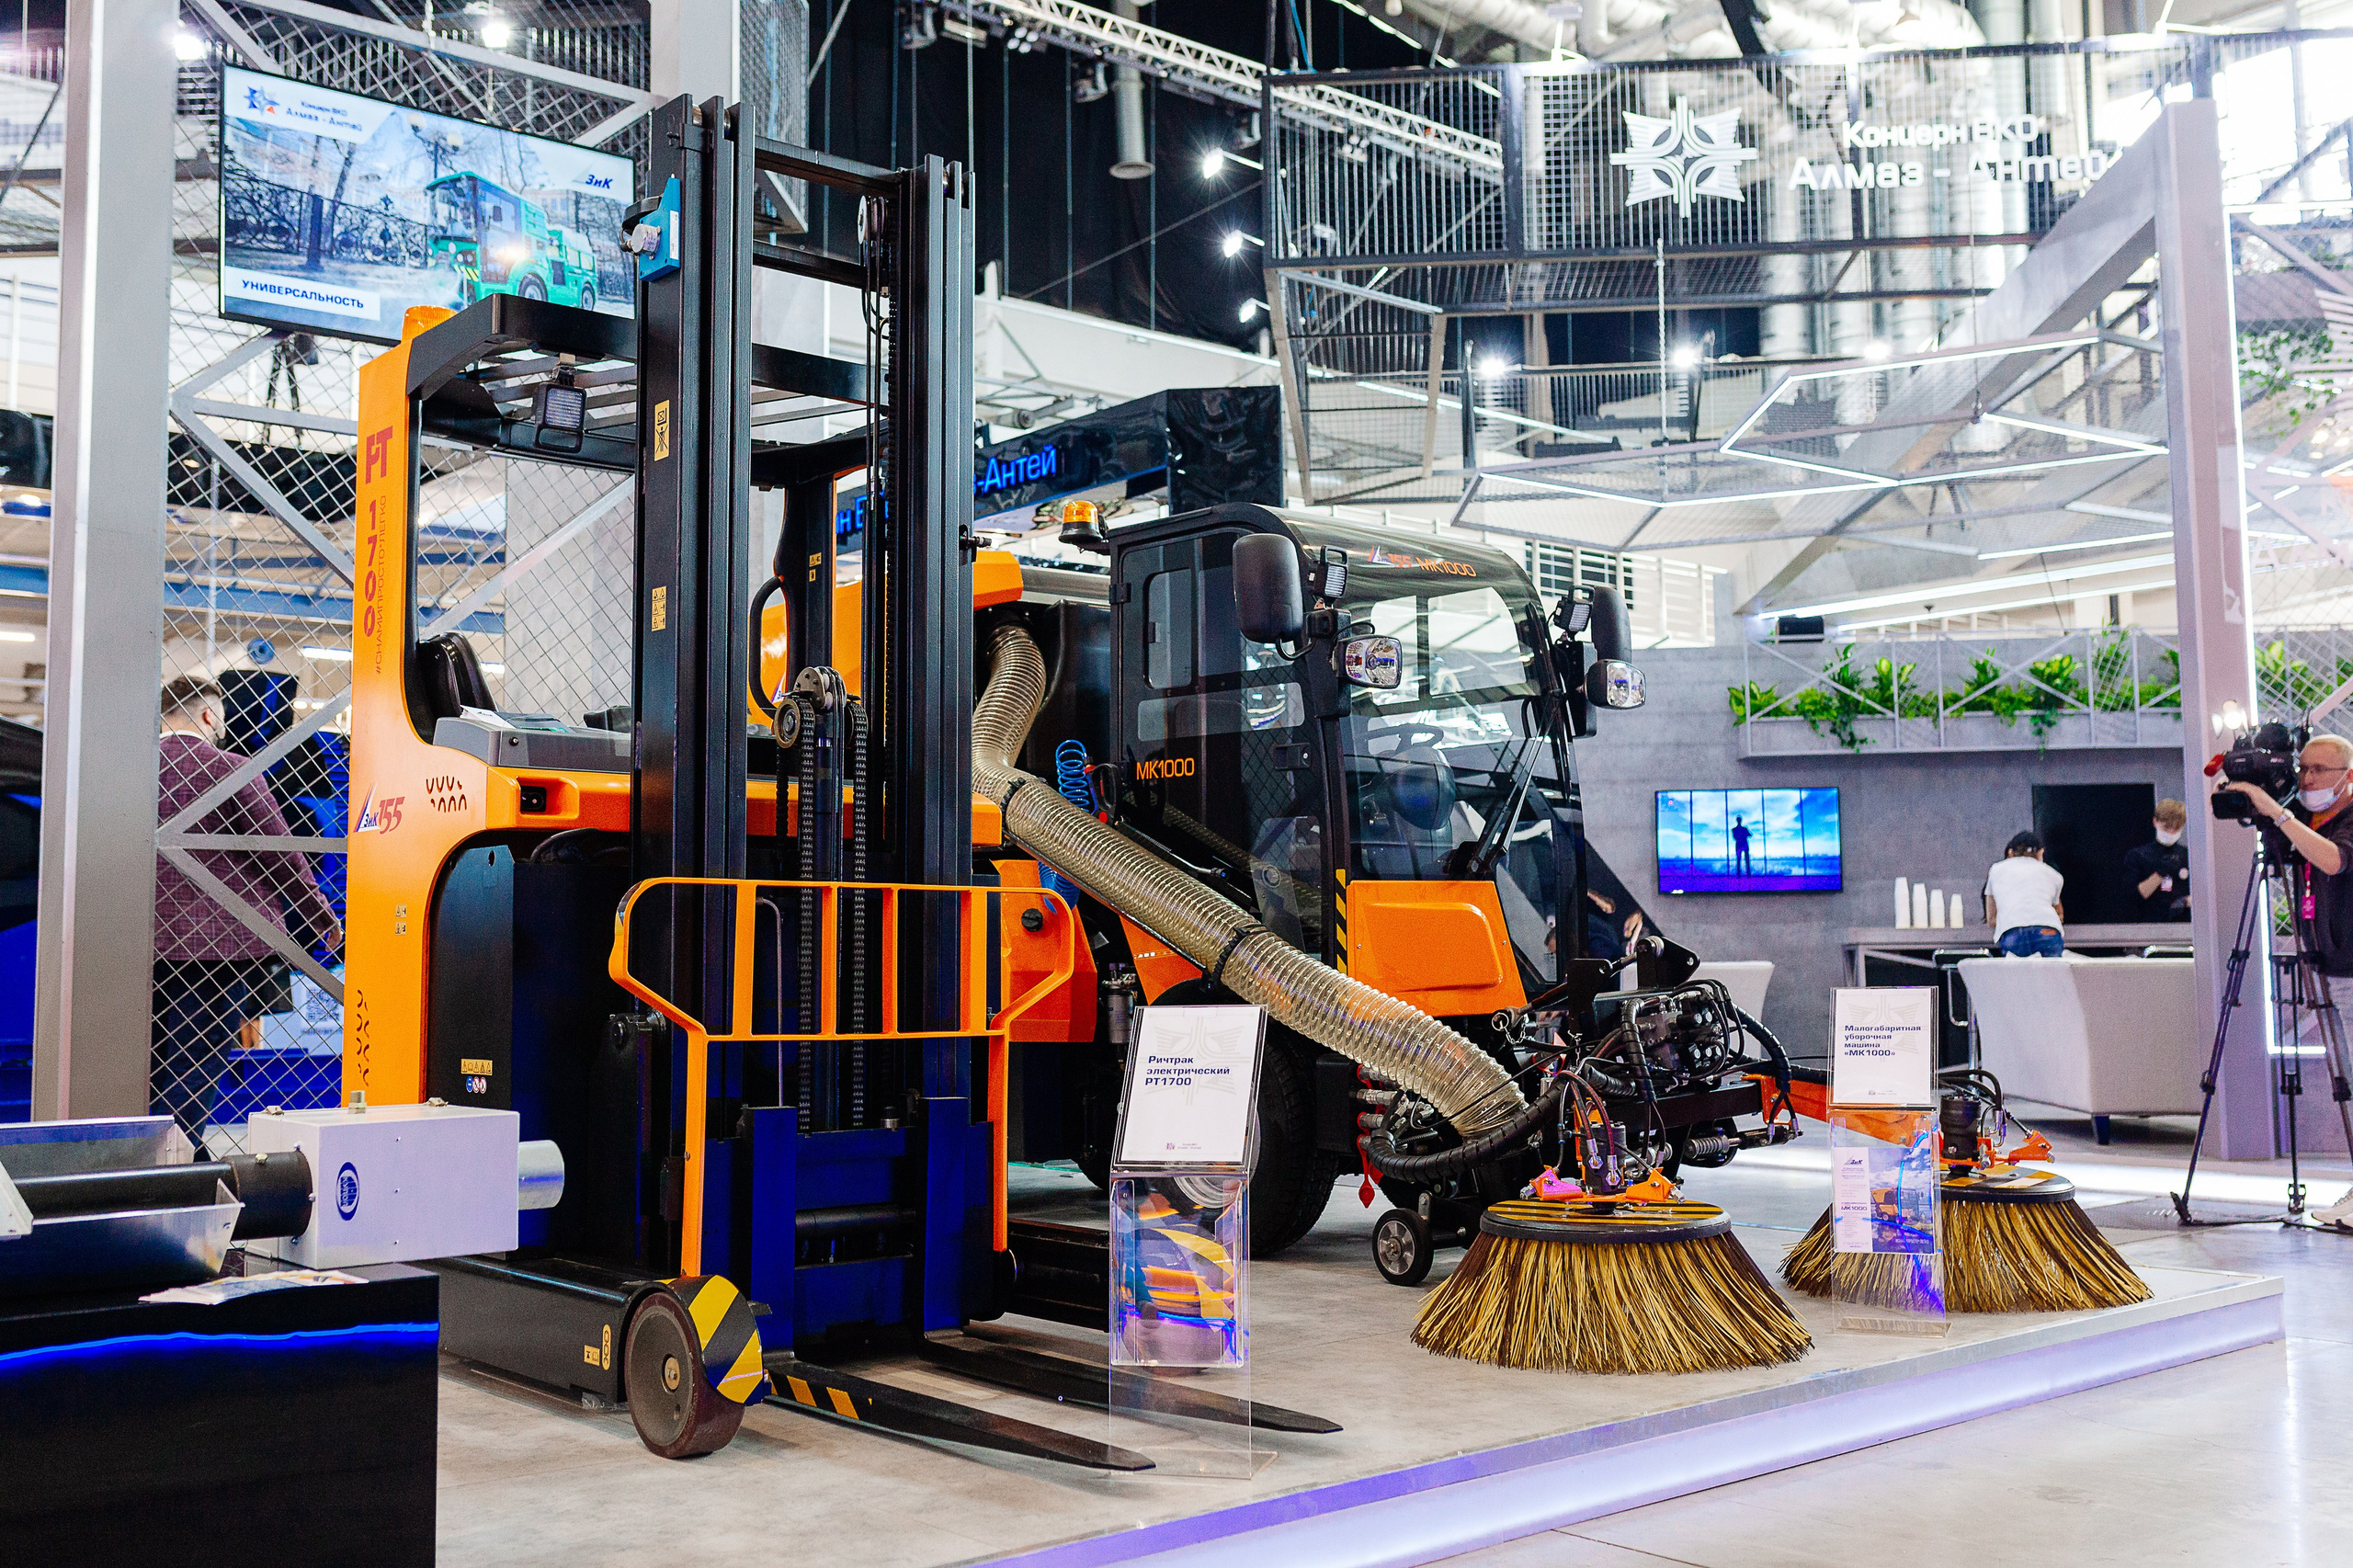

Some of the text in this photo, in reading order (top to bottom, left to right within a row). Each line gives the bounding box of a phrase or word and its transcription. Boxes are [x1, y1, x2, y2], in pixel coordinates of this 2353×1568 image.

[1841, 113, 2040, 152] Концерн ВКО
[1788, 155, 1926, 190] Алмаз
[1969, 149, 2109, 183] Антей
[241, 278, 365, 309] УНИВЕРСАЛЬНОСТЬ
[363, 499, 379, 638] 1700
[1387, 552, 1413, 569] 155
[1415, 556, 1477, 577] МК1000
[1135, 757, 1195, 781] МК1000
[378, 796, 405, 835] 155
[1844, 1024, 1922, 1033] Малогабаритная
[1844, 1033, 1893, 1041] уборочная
[1146, 1066, 1231, 1076] электрический
[1148, 1055, 1194, 1065] Ричтрак
[1144, 1077, 1192, 1085] РТ1700
